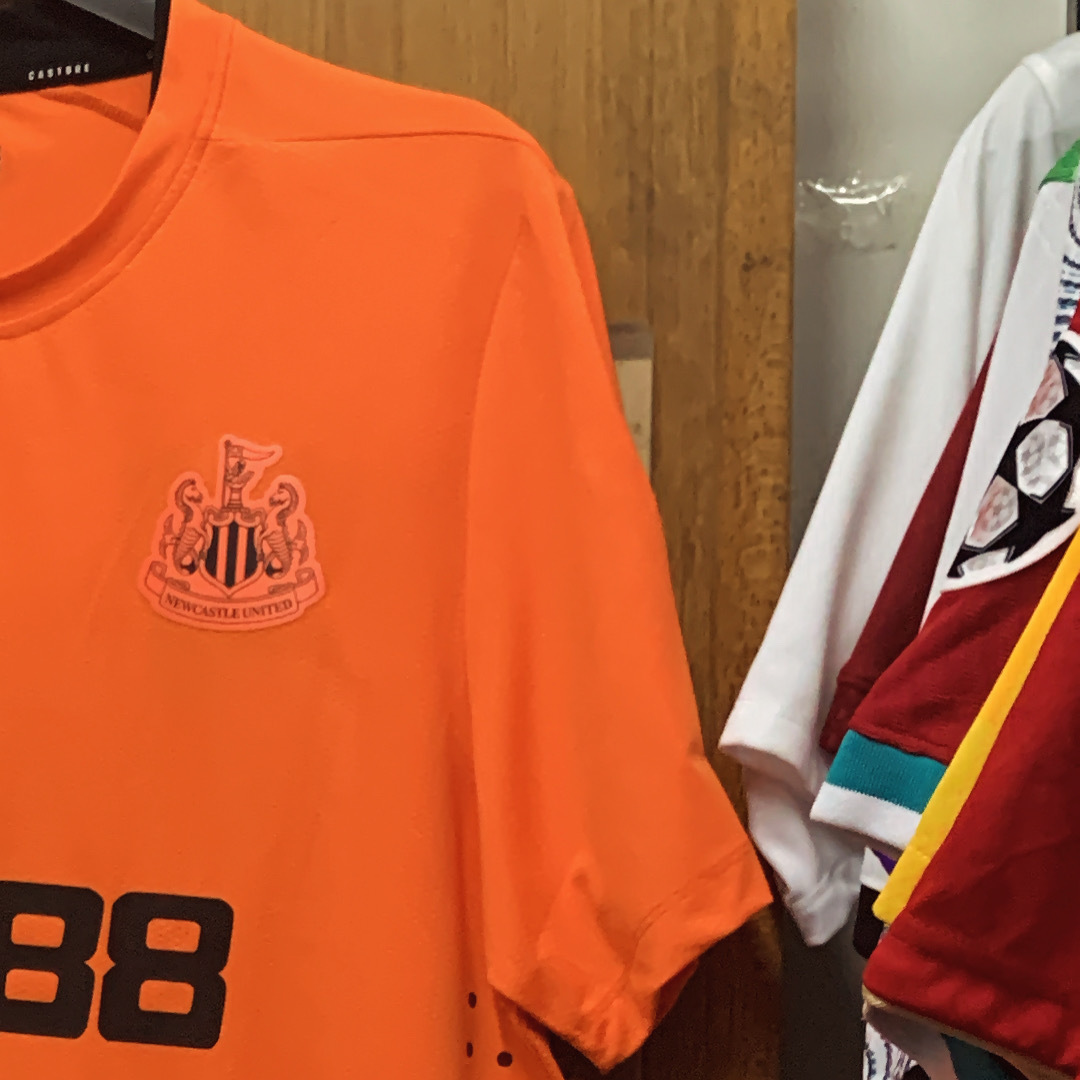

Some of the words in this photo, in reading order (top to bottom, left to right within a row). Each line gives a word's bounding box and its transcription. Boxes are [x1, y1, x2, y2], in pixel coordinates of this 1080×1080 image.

[28, 63, 91, 81] CASTORE
[166, 593, 240, 619] NEWCASTLE
[243, 599, 292, 618] UNITED
